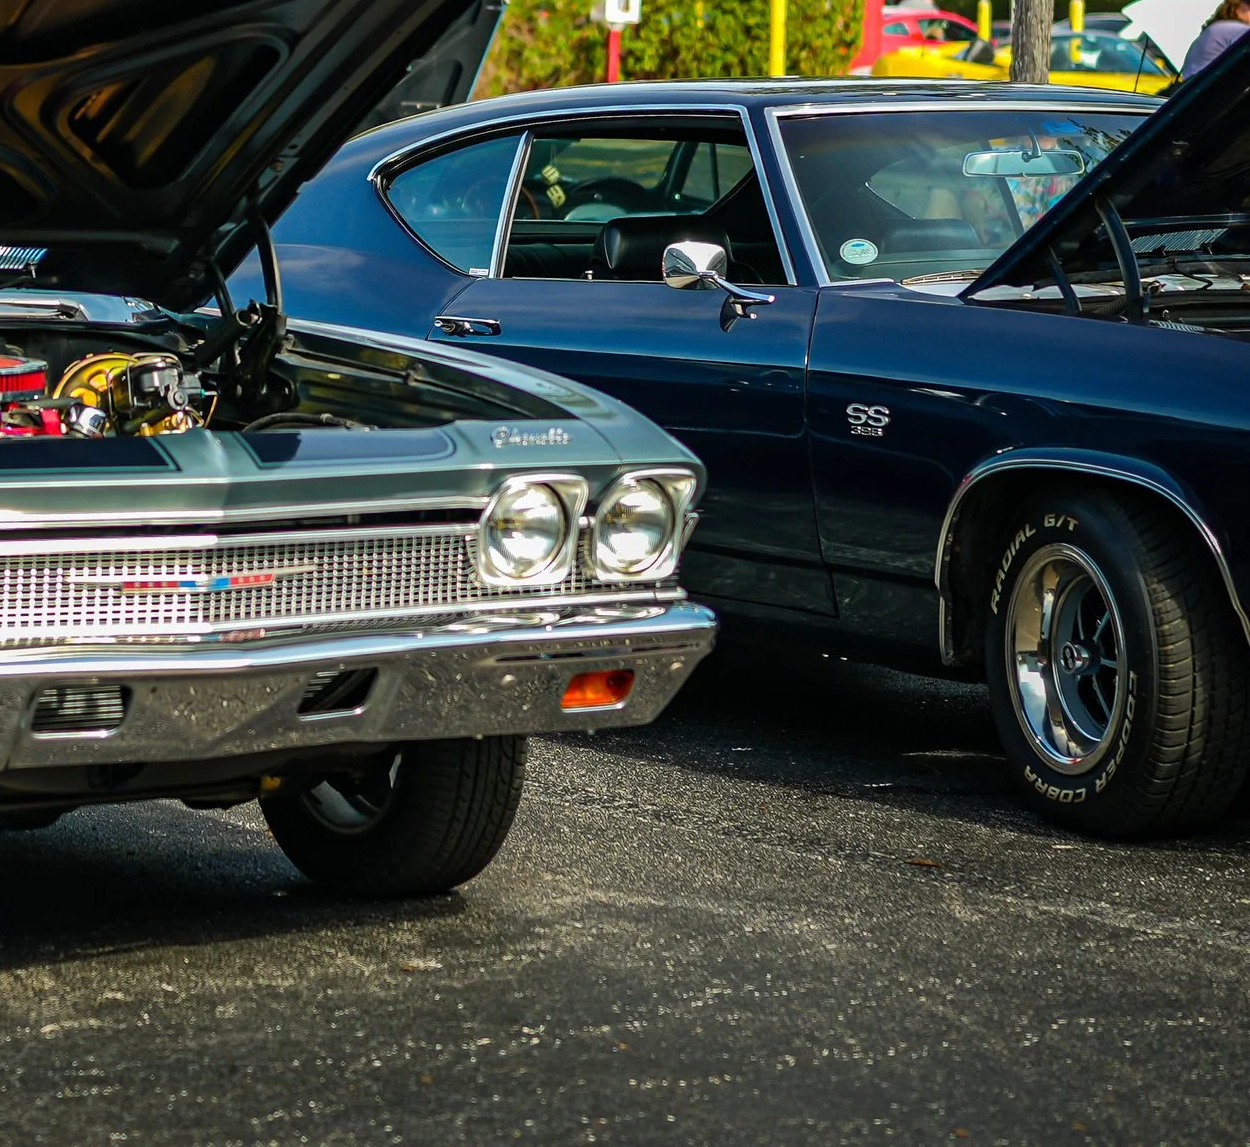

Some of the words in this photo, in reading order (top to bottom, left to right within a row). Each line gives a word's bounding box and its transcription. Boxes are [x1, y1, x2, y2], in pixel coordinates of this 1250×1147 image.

[846, 403, 891, 427] SS
[990, 523, 1037, 615] RADIAL
[1043, 513, 1079, 532] G/T
[1094, 670, 1138, 793] COOPER
[1023, 764, 1087, 803] COBRA
